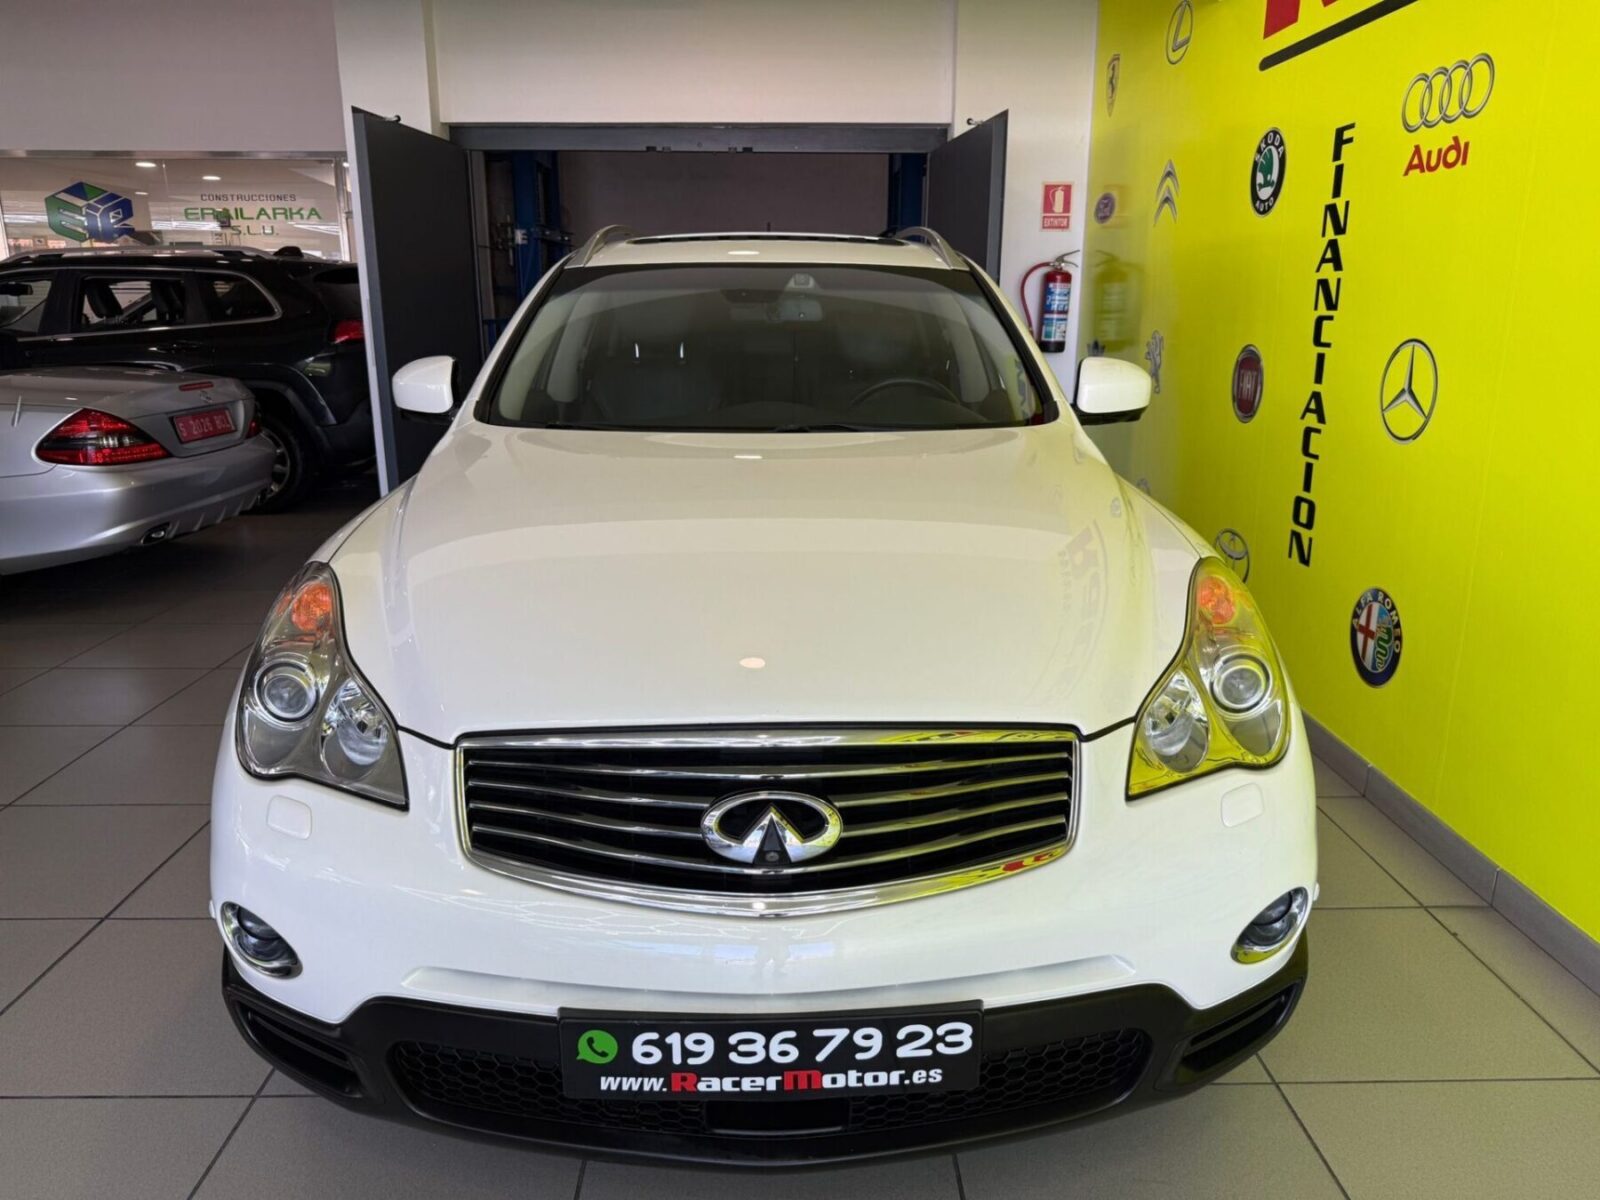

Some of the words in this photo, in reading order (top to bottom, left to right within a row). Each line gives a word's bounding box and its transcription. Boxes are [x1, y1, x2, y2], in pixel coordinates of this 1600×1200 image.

[1402, 135, 1470, 177] Audi
[200, 193, 297, 202] CONSTRUCCIONES
[1287, 122, 1356, 568] FINANCIACION
[1352, 591, 1373, 629] ALFA
[1378, 590, 1401, 654] ROMEO
[632, 1032, 715, 1065] 619
[728, 1031, 799, 1065] 36
[812, 1027, 883, 1062] 79
[896, 1021, 974, 1058] 23
[600, 1068, 942, 1092] www.RacerMotor.es
